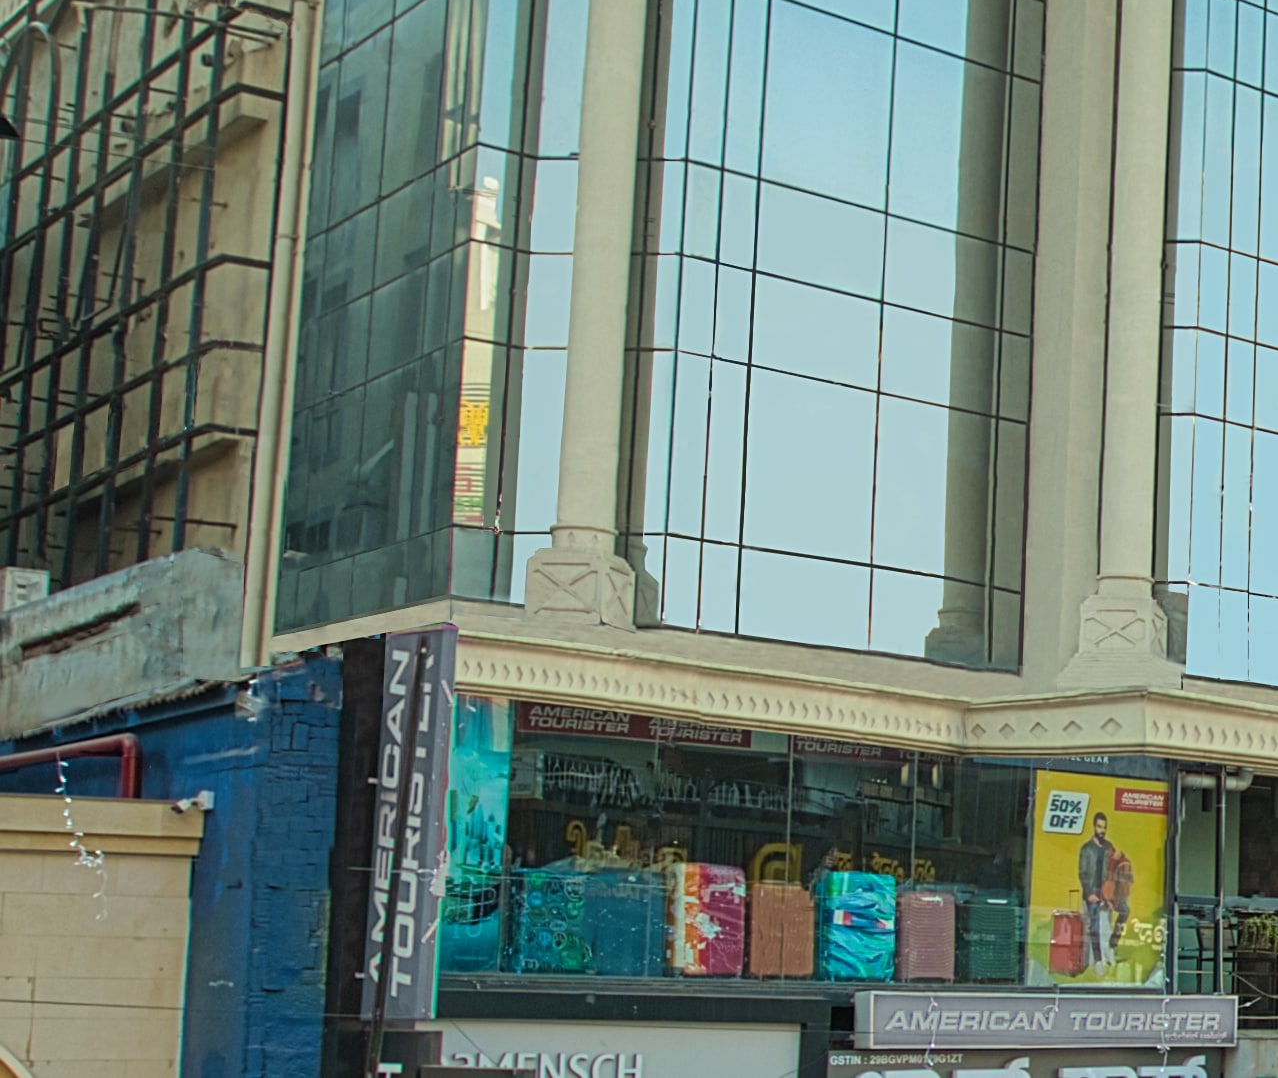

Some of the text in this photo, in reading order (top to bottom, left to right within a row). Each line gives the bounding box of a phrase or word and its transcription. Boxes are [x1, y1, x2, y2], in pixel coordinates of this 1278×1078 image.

[529, 705, 630, 722] AMERICAN
[528, 716, 630, 734] TOURISTER
[648, 726, 743, 743] TOURISTER
[796, 740, 882, 757] TOURISTER
[1049, 798, 1082, 814] 50%
[885, 1009, 1221, 1031] AMERICAN TOURISTER
[830, 1055, 862, 1065] GSTIN
